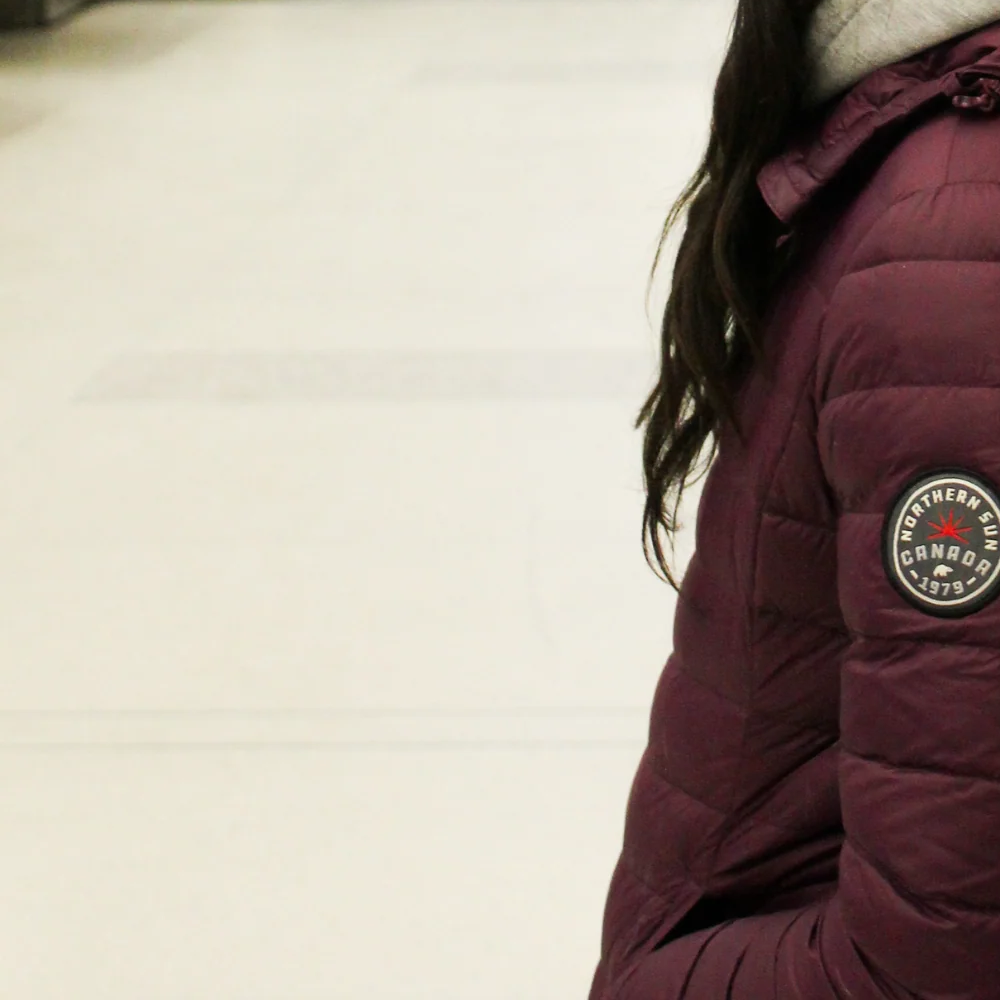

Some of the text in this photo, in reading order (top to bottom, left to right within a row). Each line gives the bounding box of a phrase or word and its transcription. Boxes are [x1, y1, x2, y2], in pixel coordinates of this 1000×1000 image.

[901, 488, 998, 550] NORTHERN SUN
[900, 543, 992, 576] CANADA
